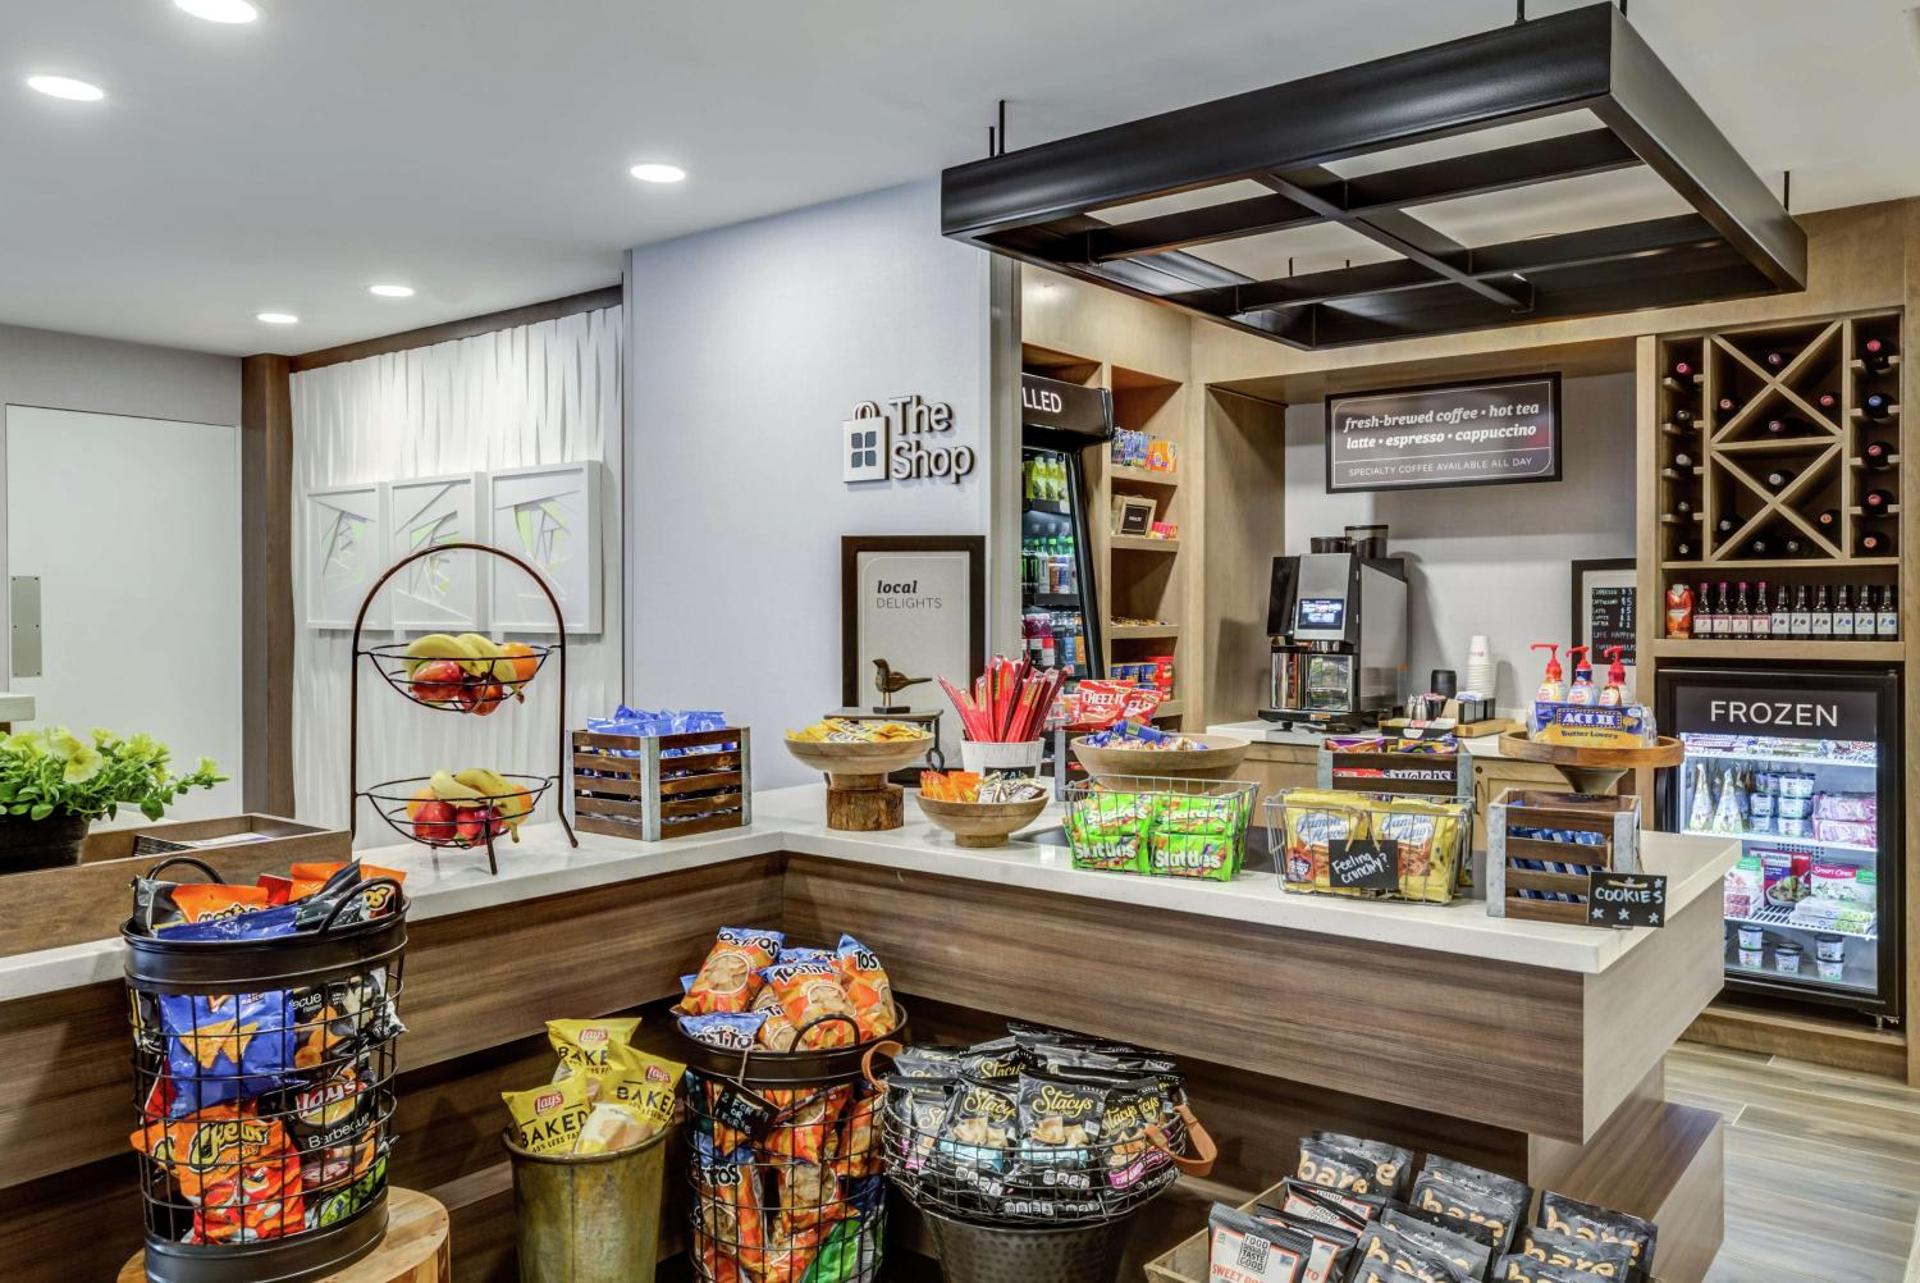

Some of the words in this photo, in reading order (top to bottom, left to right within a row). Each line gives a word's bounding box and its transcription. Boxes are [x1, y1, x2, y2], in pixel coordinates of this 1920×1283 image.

[888, 395, 953, 436] The
[1343, 410, 1433, 433] fresh-brewed
[1435, 407, 1478, 424] coffee
[1488, 404, 1512, 418] hot
[1516, 403, 1540, 415] tea
[1346, 437, 1376, 450] latte
[1385, 432, 1445, 448] espresso
[1455, 424, 1537, 442] cappuccino
[891, 440, 975, 484] Shop
[1349, 466, 1397, 477] SPECIALTY
[1399, 463, 1434, 473] COFFEE
[1437, 460, 1488, 471] AVAILABLE
[1491, 458, 1510, 468] ALL
[1512, 456, 1533, 467] DAY
[877, 580, 918, 594] local
[876, 597, 943, 609] DELIGHTS
[1562, 713, 1595, 724] ACT
[1710, 700, 1838, 727] FROZEN
[1331, 851, 1372, 875] Feeling
[1595, 887, 1663, 904] COOKIES
[1243, 1249, 1266, 1263] TASTE
